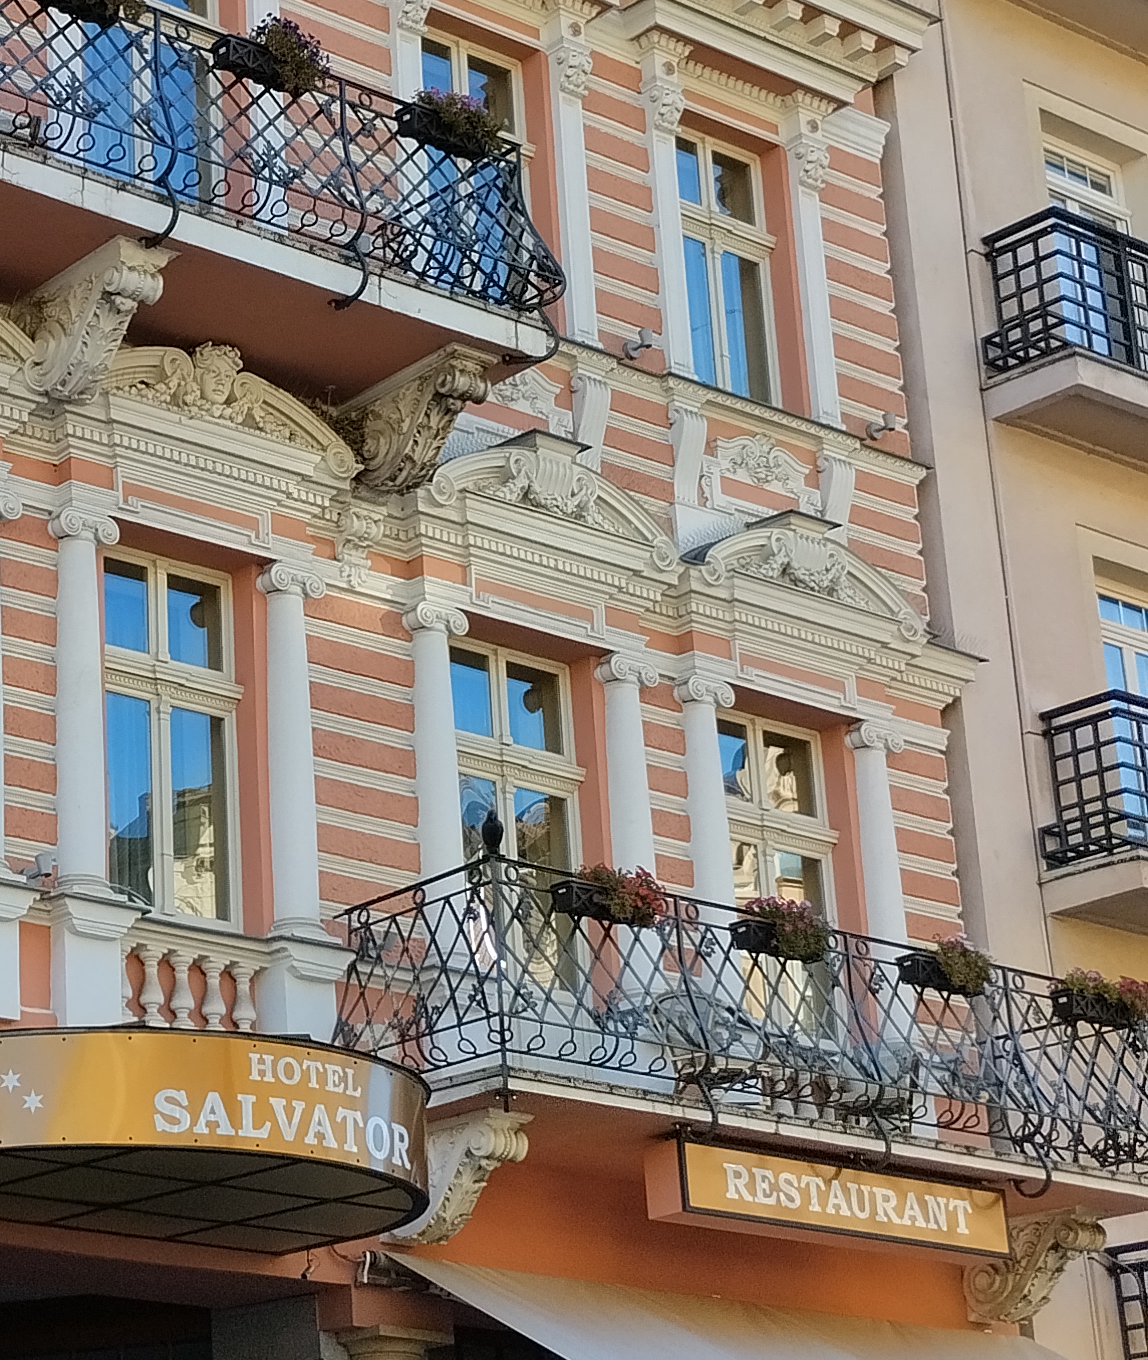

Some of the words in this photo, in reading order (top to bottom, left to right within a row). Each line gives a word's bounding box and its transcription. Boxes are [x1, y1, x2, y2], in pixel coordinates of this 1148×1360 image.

[248, 1052, 361, 1097] HOTEL
[153, 1088, 411, 1171] SALVATOR
[723, 1163, 972, 1234] RESTAURANT
